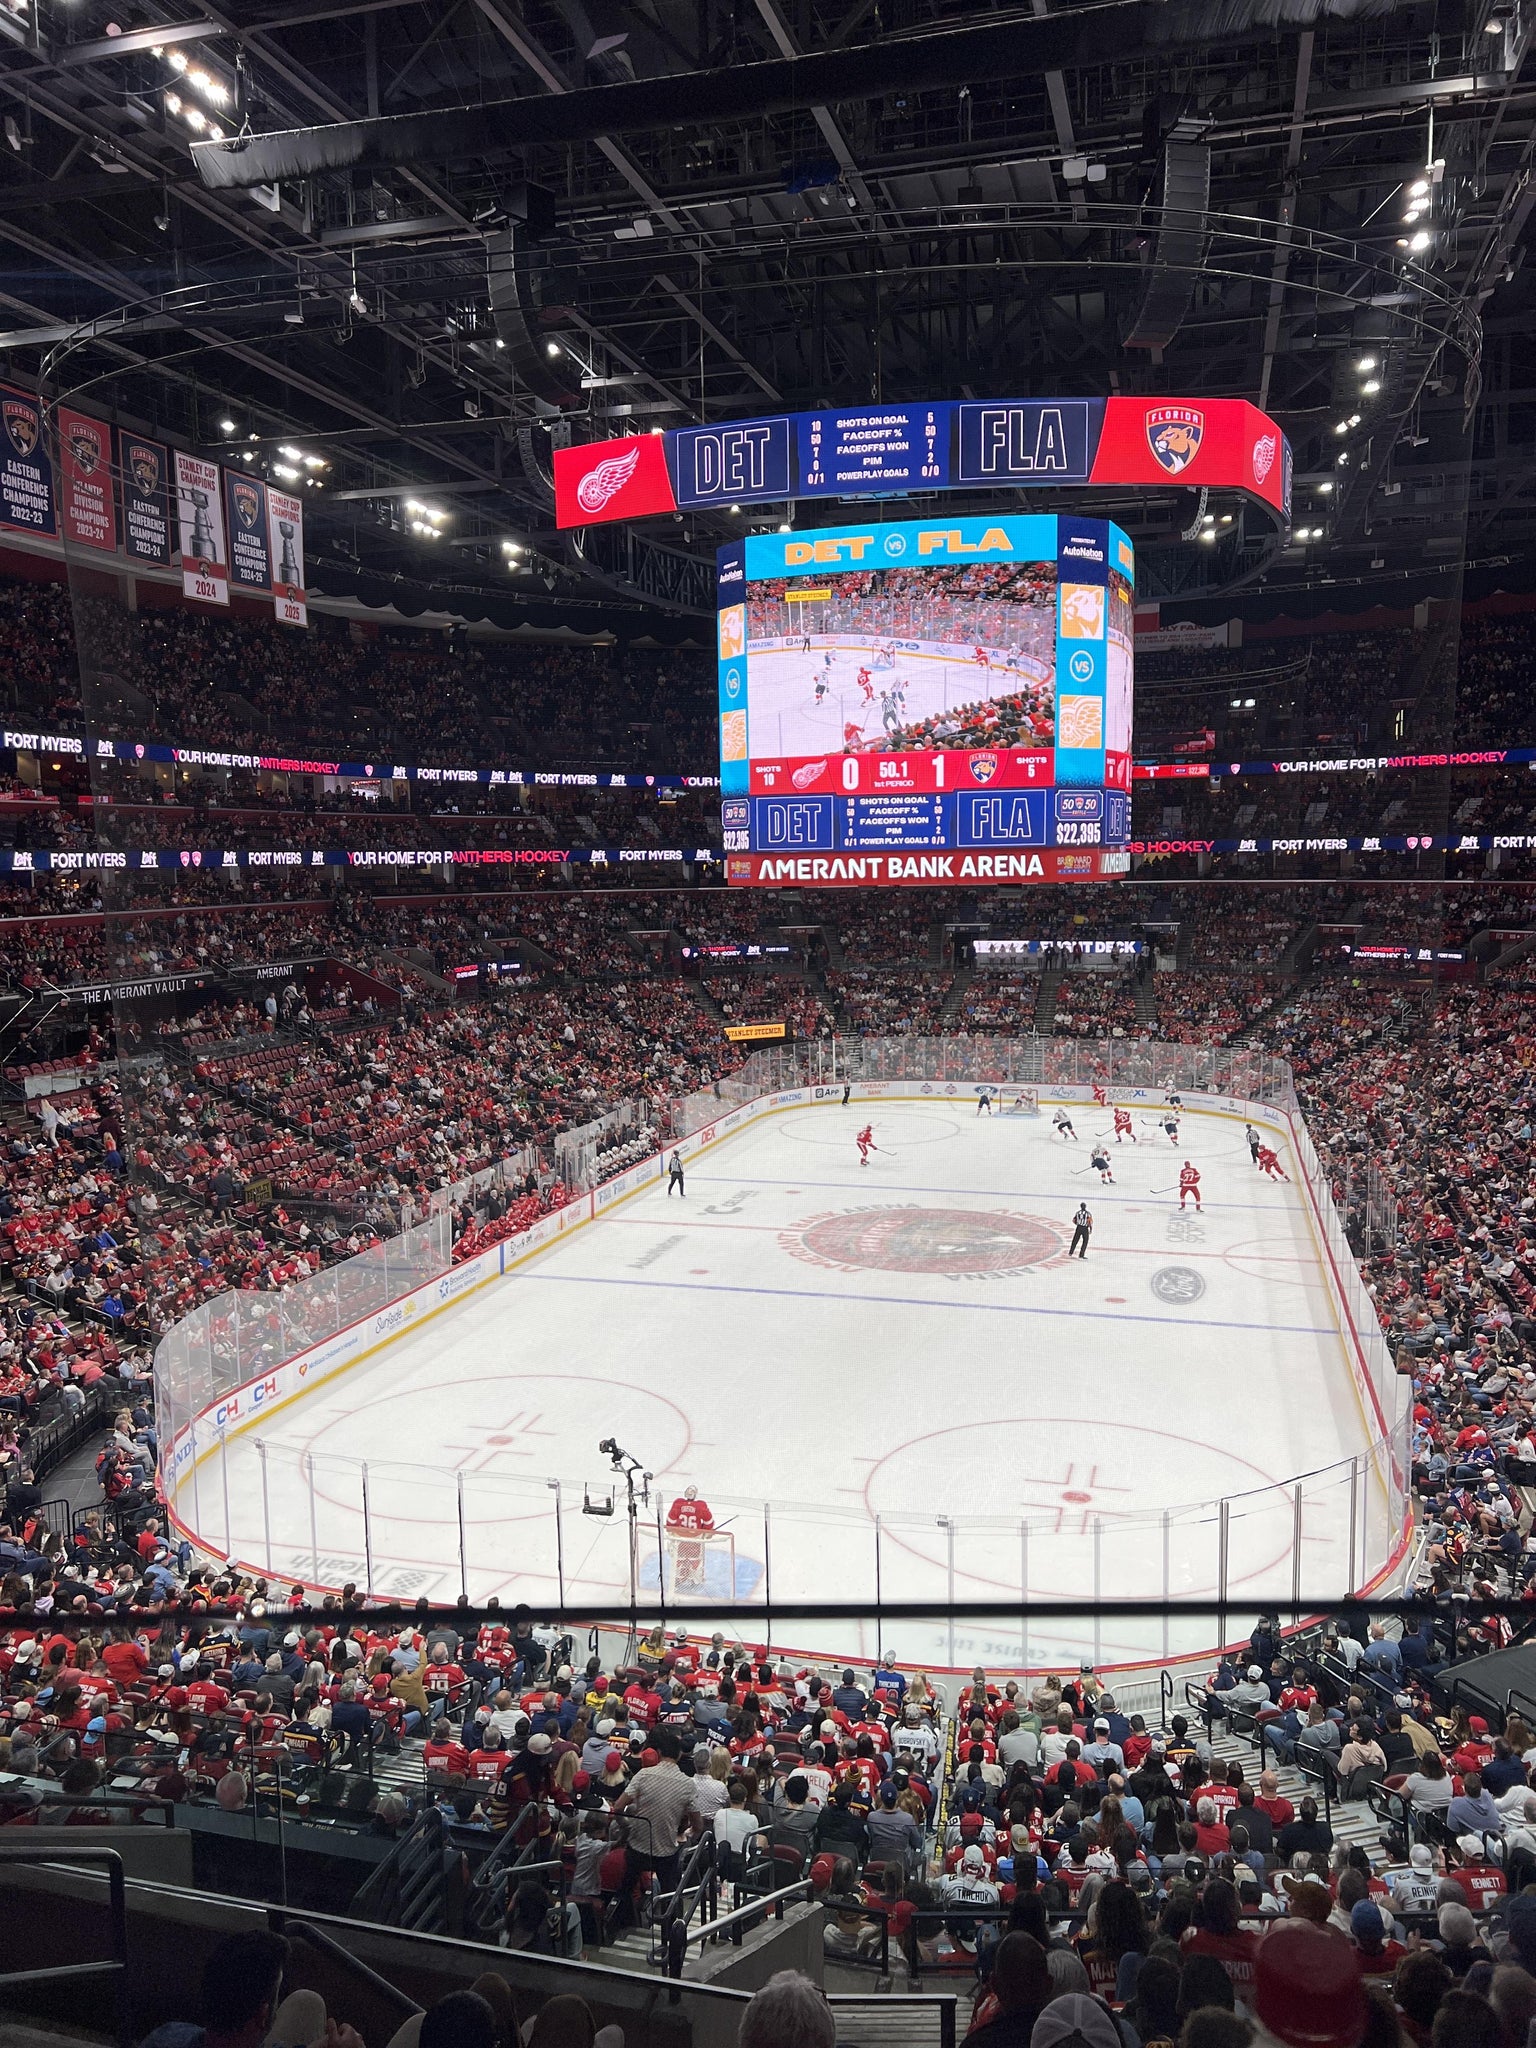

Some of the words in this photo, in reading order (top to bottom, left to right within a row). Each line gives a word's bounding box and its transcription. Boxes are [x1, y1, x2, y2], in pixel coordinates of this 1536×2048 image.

[6, 404, 34, 420] FLORIDA
[1151, 409, 1199, 424] FLORIDA
[811, 420, 821, 432] 10
[837, 418, 868, 428] SHOTS
[869, 416, 882, 426] ON
[884, 415, 909, 425] GOAL
[927, 412, 934, 423] 5
[72, 426, 98, 442] FLORIDA
[810, 434, 821, 445] 50
[843, 430, 891, 440] FACEOFF
[893, 429, 902, 438] %
[925, 426, 936, 436] 50
[981, 410, 1068, 472] FLA
[132, 450, 158, 464] FLORIDA
[814, 447, 819, 458] 7
[837, 443, 884, 454] FACEOFFS
[885, 441, 910, 451] WON
[928, 439, 934, 450] 7
[7, 460, 40, 481] EASTERN
[178, 457, 202, 474] STANLEY
[204, 466, 216, 479] CUP
[696, 428, 770, 495] DET
[814, 460, 820, 471] 0
[863, 456, 882, 466] PIM
[928, 452, 934, 463] 2
[180, 472, 216, 492] CHAMPIONS
[808, 473, 824, 484] 0/1
[837, 471, 862, 481] POWER
[863, 470, 882, 479] PLAY
[883, 468, 909, 478] GOALS
[921, 465, 940, 477] 0/0
[1, 472, 49, 497] CONFERENCE
[72, 480, 104, 498] ATLANTIC
[2, 488, 49, 512] CHAMPIONS
[74, 494, 104, 513] DIVISION
[132, 500, 160, 516] EASTERN
[269, 493, 290, 508] STANLEY
[290, 500, 300, 511] CUP
[11, 504, 44, 524] 2022-23
[70, 508, 110, 528] CHAMPIONS
[128, 512, 166, 532] CONFERENCE
[270, 506, 300, 524] CHAMPIONS
[76, 522, 104, 541] 2023-24
[130, 525, 165, 546] CHAMPIONS
[238, 532, 261, 547] EASTERN
[136, 540, 162, 558] 2023-24
[234, 542, 266, 560] CONFERENCE
[784, 536, 874, 566] DET
[889, 540, 902, 550] VS
[918, 528, 1014, 556] FLA
[1062, 546, 1104, 560] AutoNation
[234, 554, 266, 572] CHAMPIONS
[240, 568, 263, 584] 2024-25
[195, 580, 216, 598] 2024
[284, 604, 300, 620] 2025
[1074, 660, 1090, 673] VS
[728, 678, 738, 690] VS
[4, 732, 39, 750] FORT
[40, 736, 82, 754] MYERS
[172, 748, 201, 764] YOUR
[202, 751, 231, 766] HOME
[232, 754, 252, 767] FOR
[253, 756, 300, 773] PANTHERS
[301, 760, 340, 774] HOCKEY
[755, 765, 782, 773] SHOTS
[1016, 756, 1048, 764] SHOTS
[1272, 760, 1308, 773] YOUR
[1310, 760, 1348, 771] HOME
[1350, 758, 1378, 770] FOR
[1378, 754, 1448, 768] PANTHERS
[1449, 751, 1508, 765] HOCKEY
[417, 768, 442, 780] FORT
[443, 770, 478, 782] MYERS
[534, 773, 560, 785] FORT
[562, 774, 598, 786] MYERS
[842, 758, 859, 790] 0
[880, 761, 908, 778] 50.1
[932, 754, 944, 788] 1
[1028, 764, 1035, 778] 5
[681, 776, 713, 788] YOUR
[764, 774, 775, 786] 10
[885, 780, 914, 788] PERIOD
[904, 796, 928, 804] GOAL
[936, 796, 941, 804] 5
[1062, 799, 1074, 810] 50
[1084, 798, 1097, 809] 50
[768, 804, 822, 842] DET
[972, 798, 1032, 839] FLA
[1056, 823, 1101, 845] $22,395
[1146, 840, 1214, 854] HOCKEY
[1272, 839, 1304, 850] FORT
[1306, 838, 1348, 850] MYERS
[1494, 836, 1526, 848] FORT
[50, 852, 84, 868] FORT
[86, 852, 126, 868] MYERS
[248, 852, 272, 865] FORT
[274, 851, 302, 865] MYERS
[347, 852, 376, 866] YOUR
[378, 852, 415, 864] HOME
[416, 852, 443, 864] FOR
[444, 850, 513, 864] PANTHERS
[514, 850, 570, 863] HOCKEY
[619, 850, 646, 861] FORT
[648, 850, 683, 861] MYERS
[758, 858, 884, 880] AMERANT
[888, 856, 954, 878] BANK
[960, 854, 1044, 876] ARENA
[256, 965, 294, 980] AMERANT
[82, 990, 100, 1004] THE
[103, 984, 152, 1002] AMERANT
[155, 980, 188, 994] VAULT
[728, 1028, 753, 1038] STANLEY
[754, 1027, 782, 1036] STEEMER
[824, 1088, 840, 1096] APP
[1108, 1088, 1134, 1096] OMEGA
[1134, 1090, 1148, 1098] XL
[701, 1126, 716, 1145] DEX
[842, 1202, 922, 1214] ARENA
[254, 1378, 276, 1402] CH
[216, 1399, 238, 1425] CH
[679, 1515, 698, 1530] 36
[627, 1696, 649, 1710] FLORIDA
[1214, 1795, 1236, 1806] BARKOV
[1470, 1878, 1501, 1890] BENNETT
